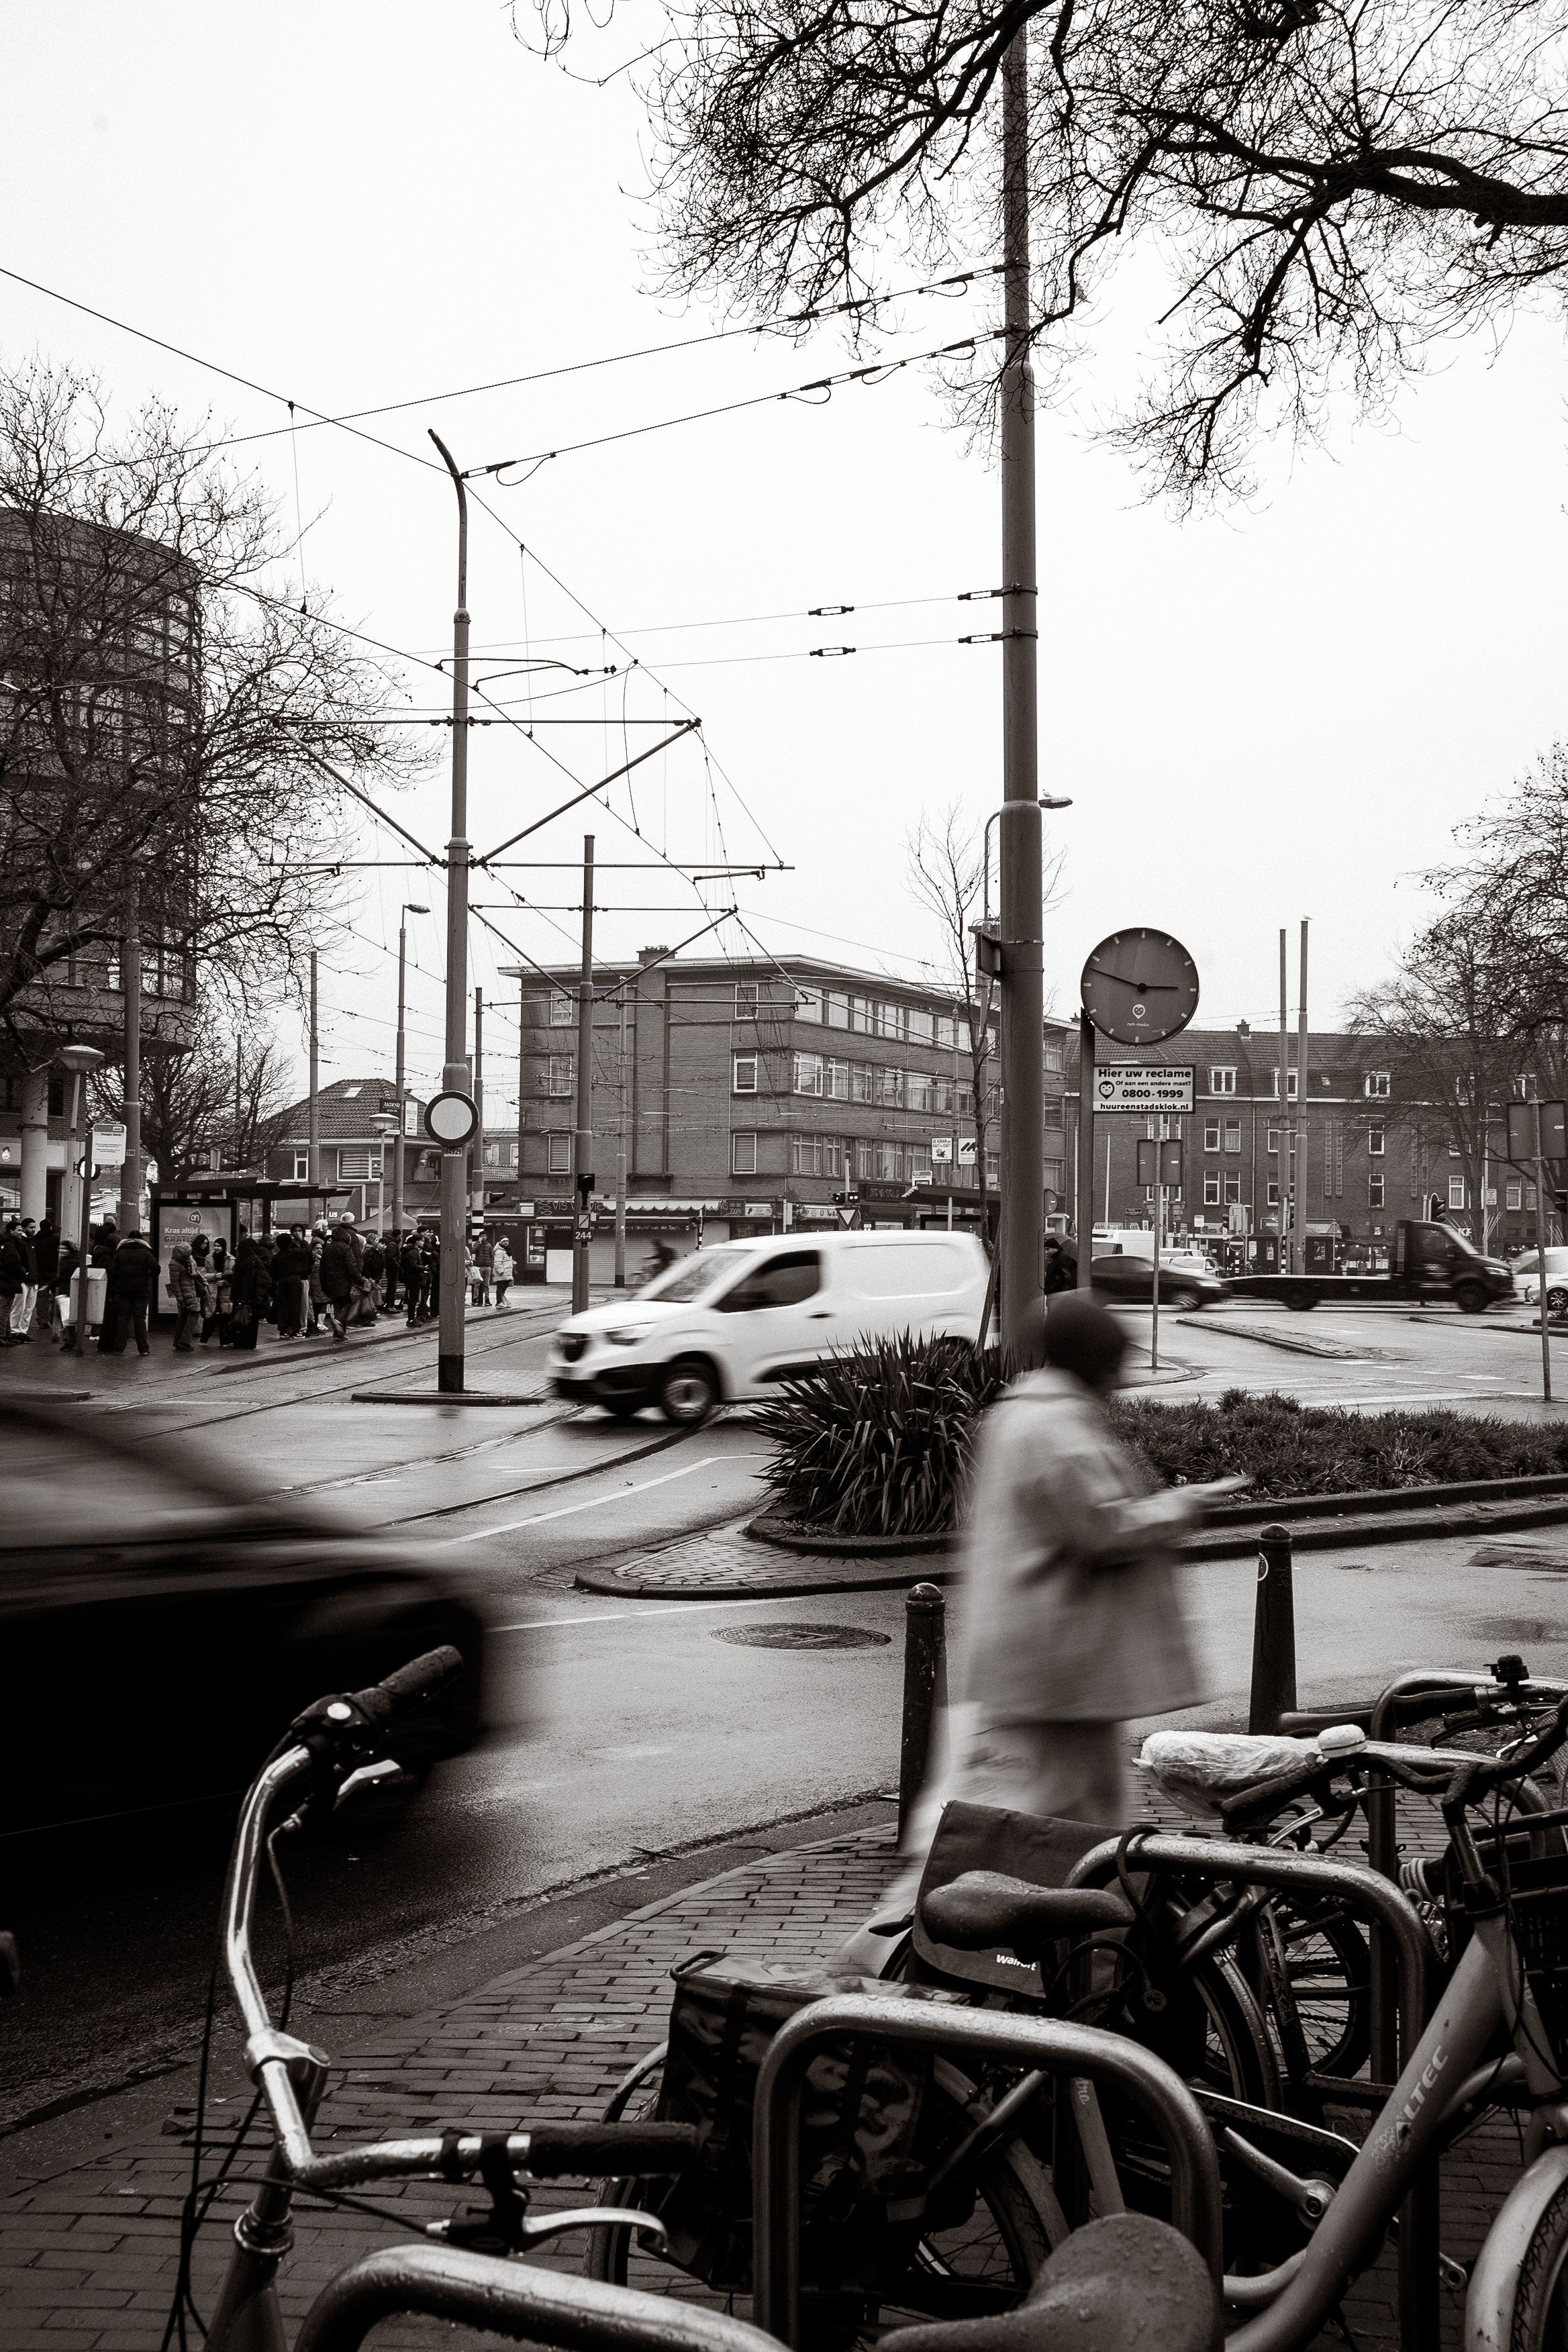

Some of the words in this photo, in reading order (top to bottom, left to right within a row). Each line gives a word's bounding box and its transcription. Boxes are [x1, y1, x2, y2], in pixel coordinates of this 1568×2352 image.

[1098, 1068, 1122, 1077] Hier
[1146, 1069, 1191, 1078] reclame
[1122, 1089, 1183, 1097] 0800-1999
[552, 1201, 568, 1210] VIS
[181, 1227, 198, 1235] altijd
[575, 1231, 591, 1240] 244
